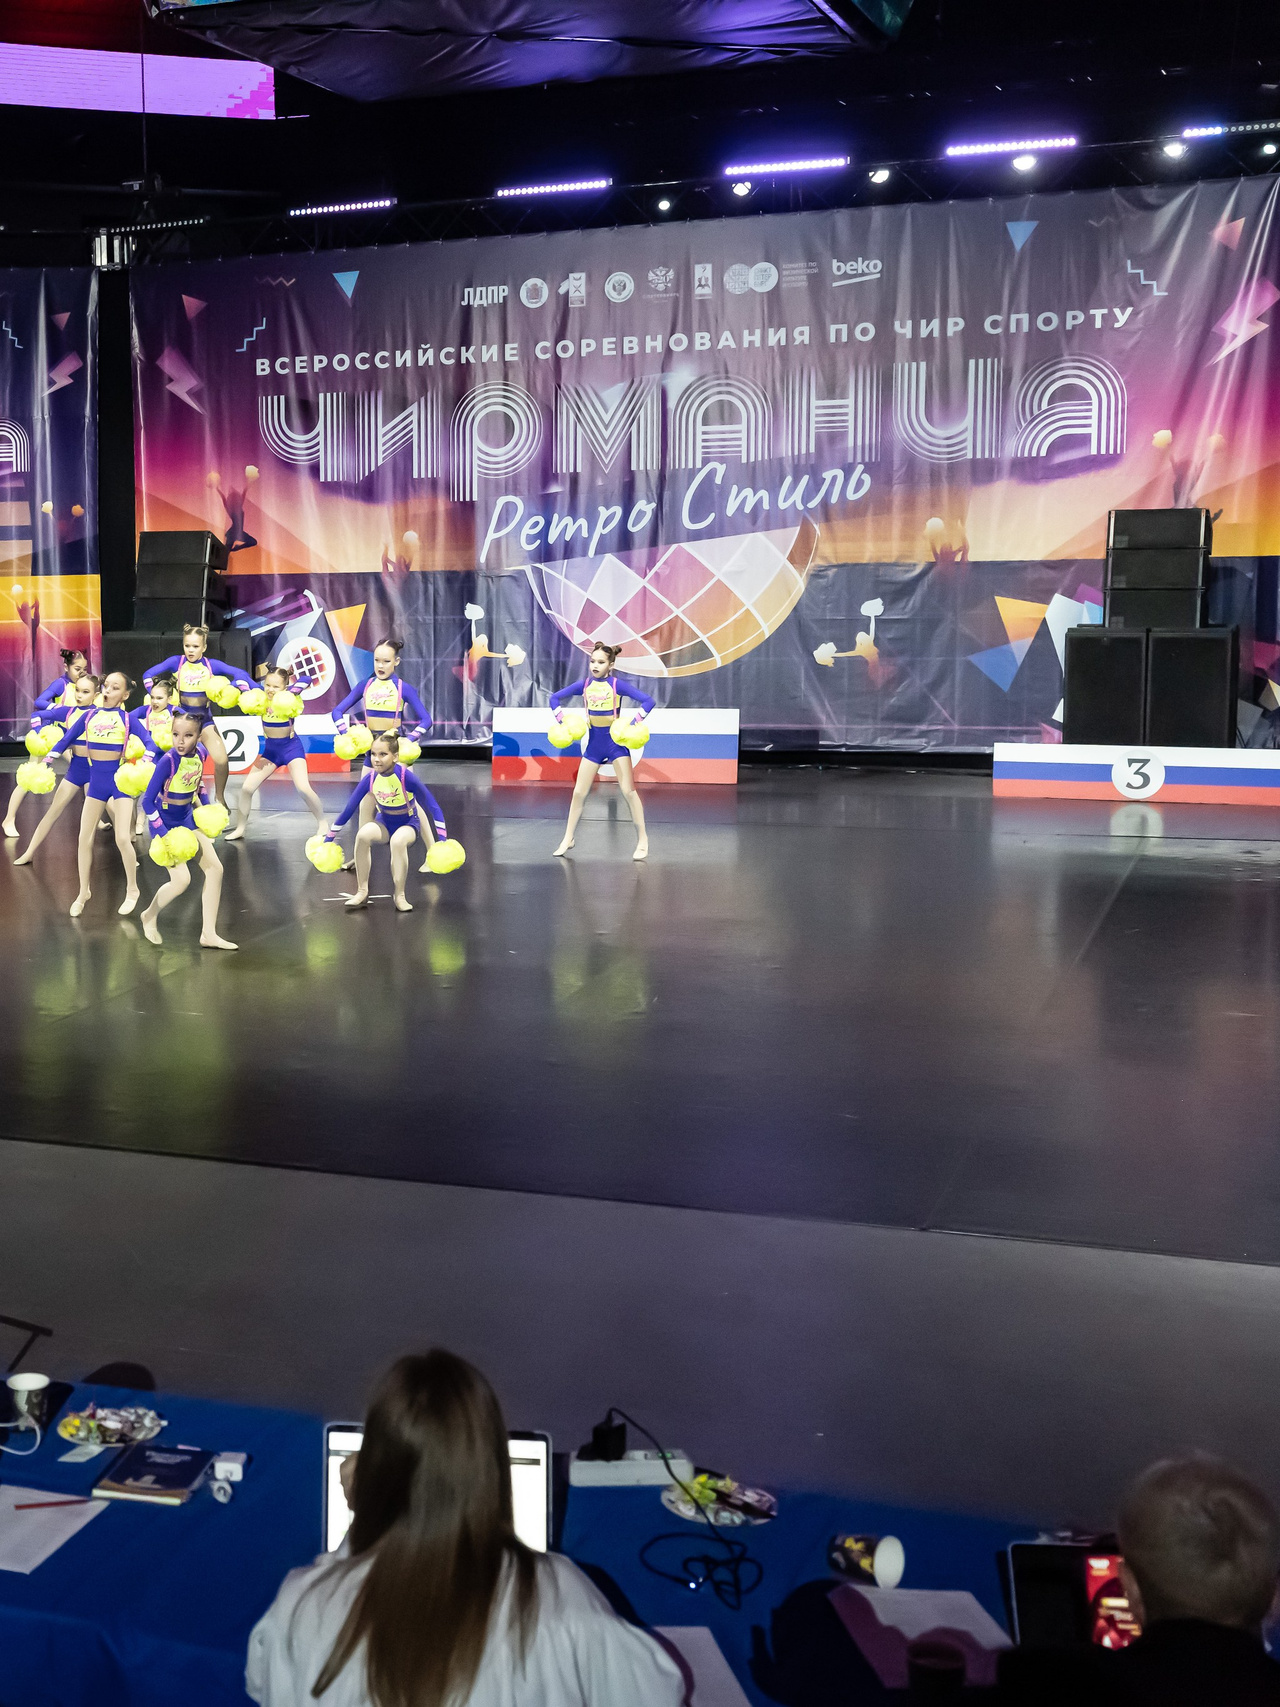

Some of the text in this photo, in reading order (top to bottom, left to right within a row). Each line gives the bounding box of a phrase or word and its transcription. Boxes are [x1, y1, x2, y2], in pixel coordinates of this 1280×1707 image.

[832, 257, 883, 275] beko
[461, 285, 509, 307] ЛДПР
[255, 306, 1134, 376] ВСЕРОССИЙСКИЕ СОРЕВНОВАНИЯ ПО ЧИР СПОРТУ
[479, 461, 872, 563] Ретро Стиль
[222, 729, 245, 762] 2
[1125, 758, 1151, 790] 3
